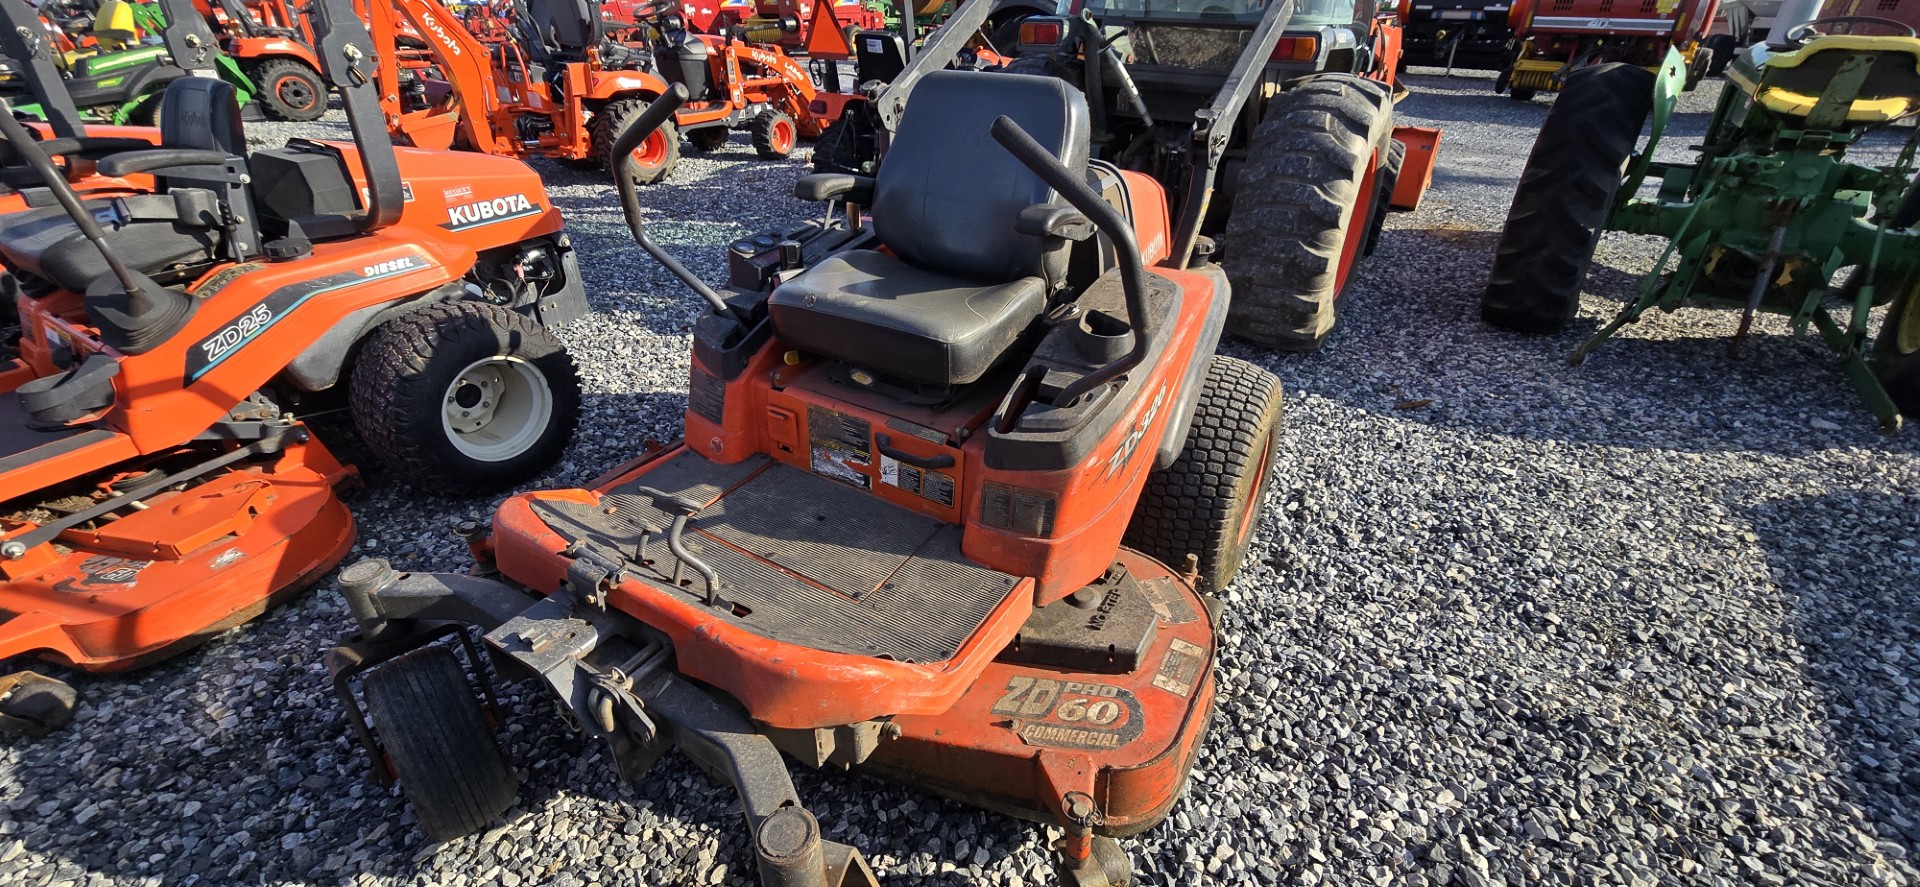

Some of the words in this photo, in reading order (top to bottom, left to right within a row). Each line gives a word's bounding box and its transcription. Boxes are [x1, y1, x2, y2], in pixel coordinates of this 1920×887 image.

[422, 11, 461, 56] Kubota
[751, 50, 777, 64] Kubota
[448, 193, 532, 226] KUBOTA
[364, 257, 414, 277] DIESEL
[202, 303, 272, 362] ZD25
[1085, 614, 1106, 631] NO
[993, 676, 1061, 716] ZD
[1063, 681, 1118, 698] PRO
[1057, 699, 1119, 725] 60
[1024, 724, 1120, 748] COMMERCIAL
